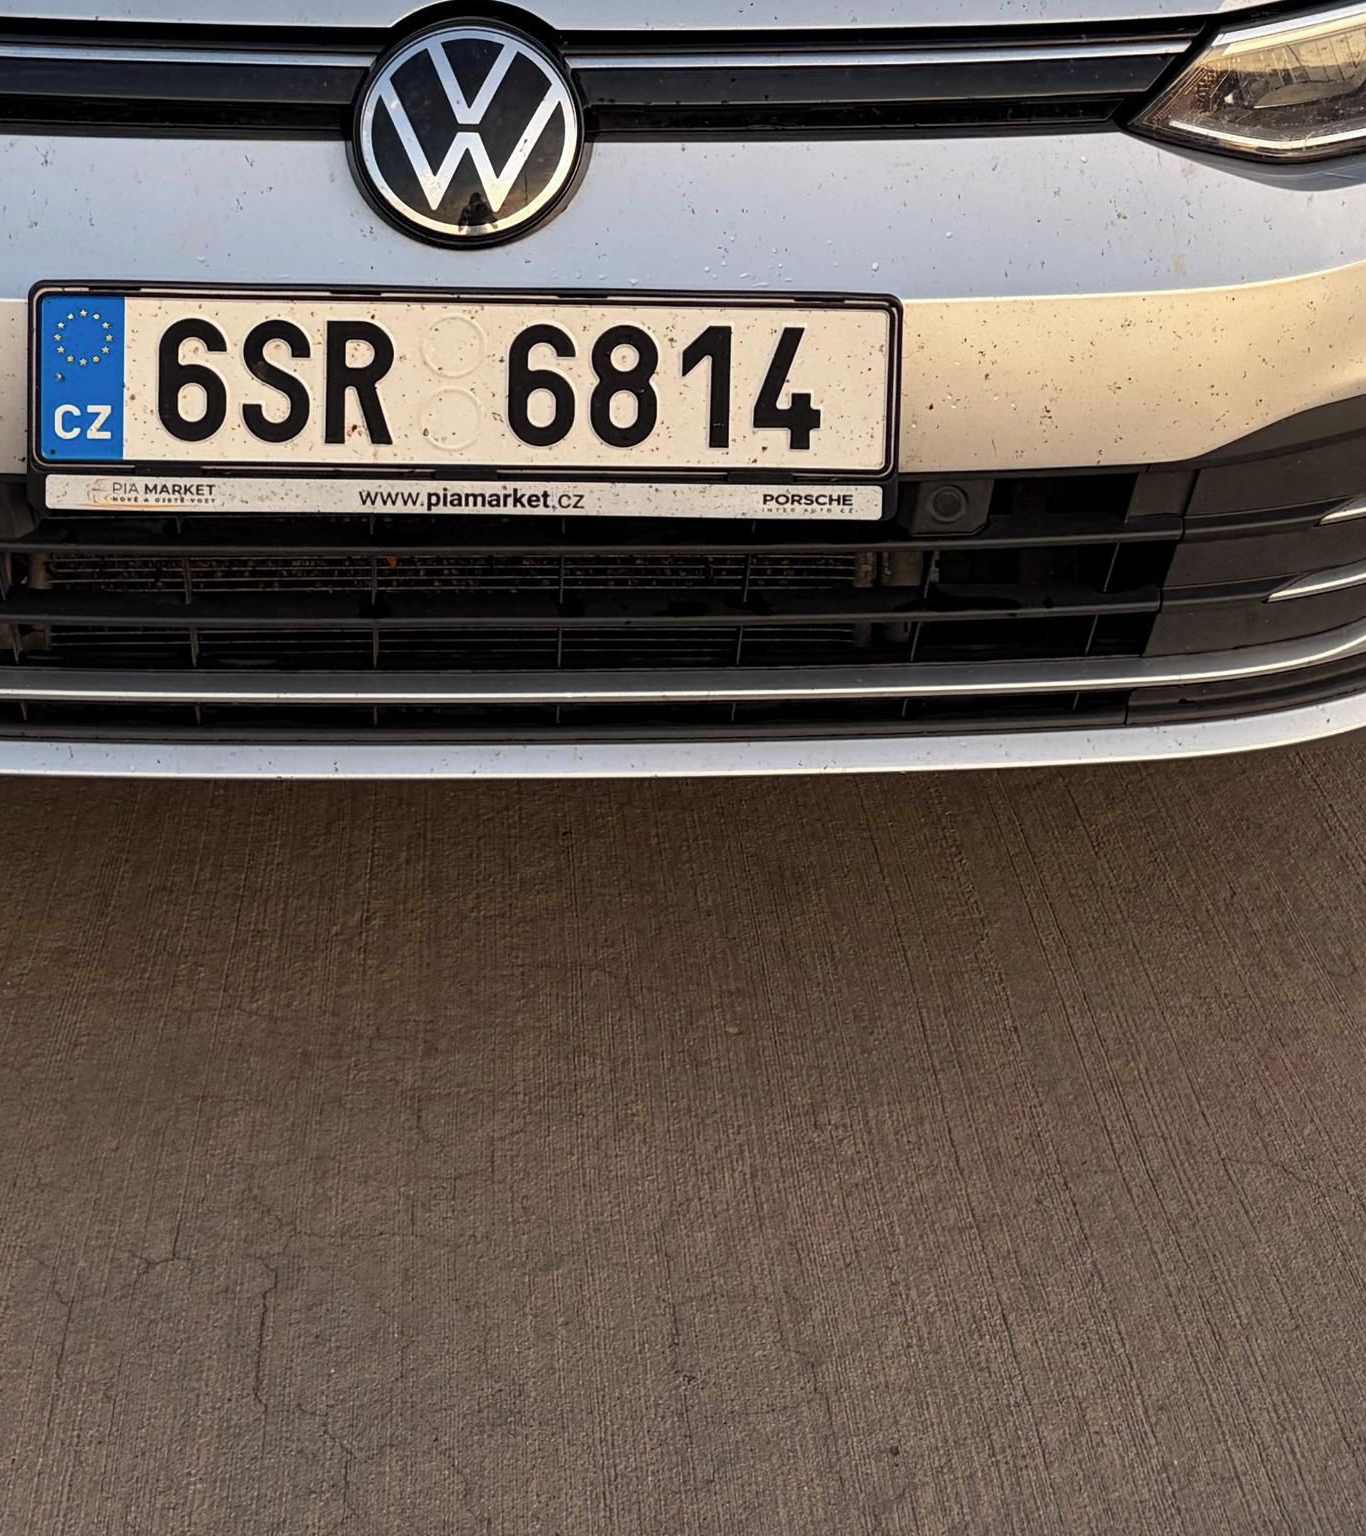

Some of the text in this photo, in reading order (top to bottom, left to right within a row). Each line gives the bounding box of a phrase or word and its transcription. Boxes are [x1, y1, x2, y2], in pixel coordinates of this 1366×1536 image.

[157, 318, 821, 450] 6SR 6814
[53, 403, 112, 440] CZ
[112, 482, 215, 496] PIA MARKET
[358, 488, 585, 511] www.piamarket.cz
[762, 494, 854, 506] PORSCHE
